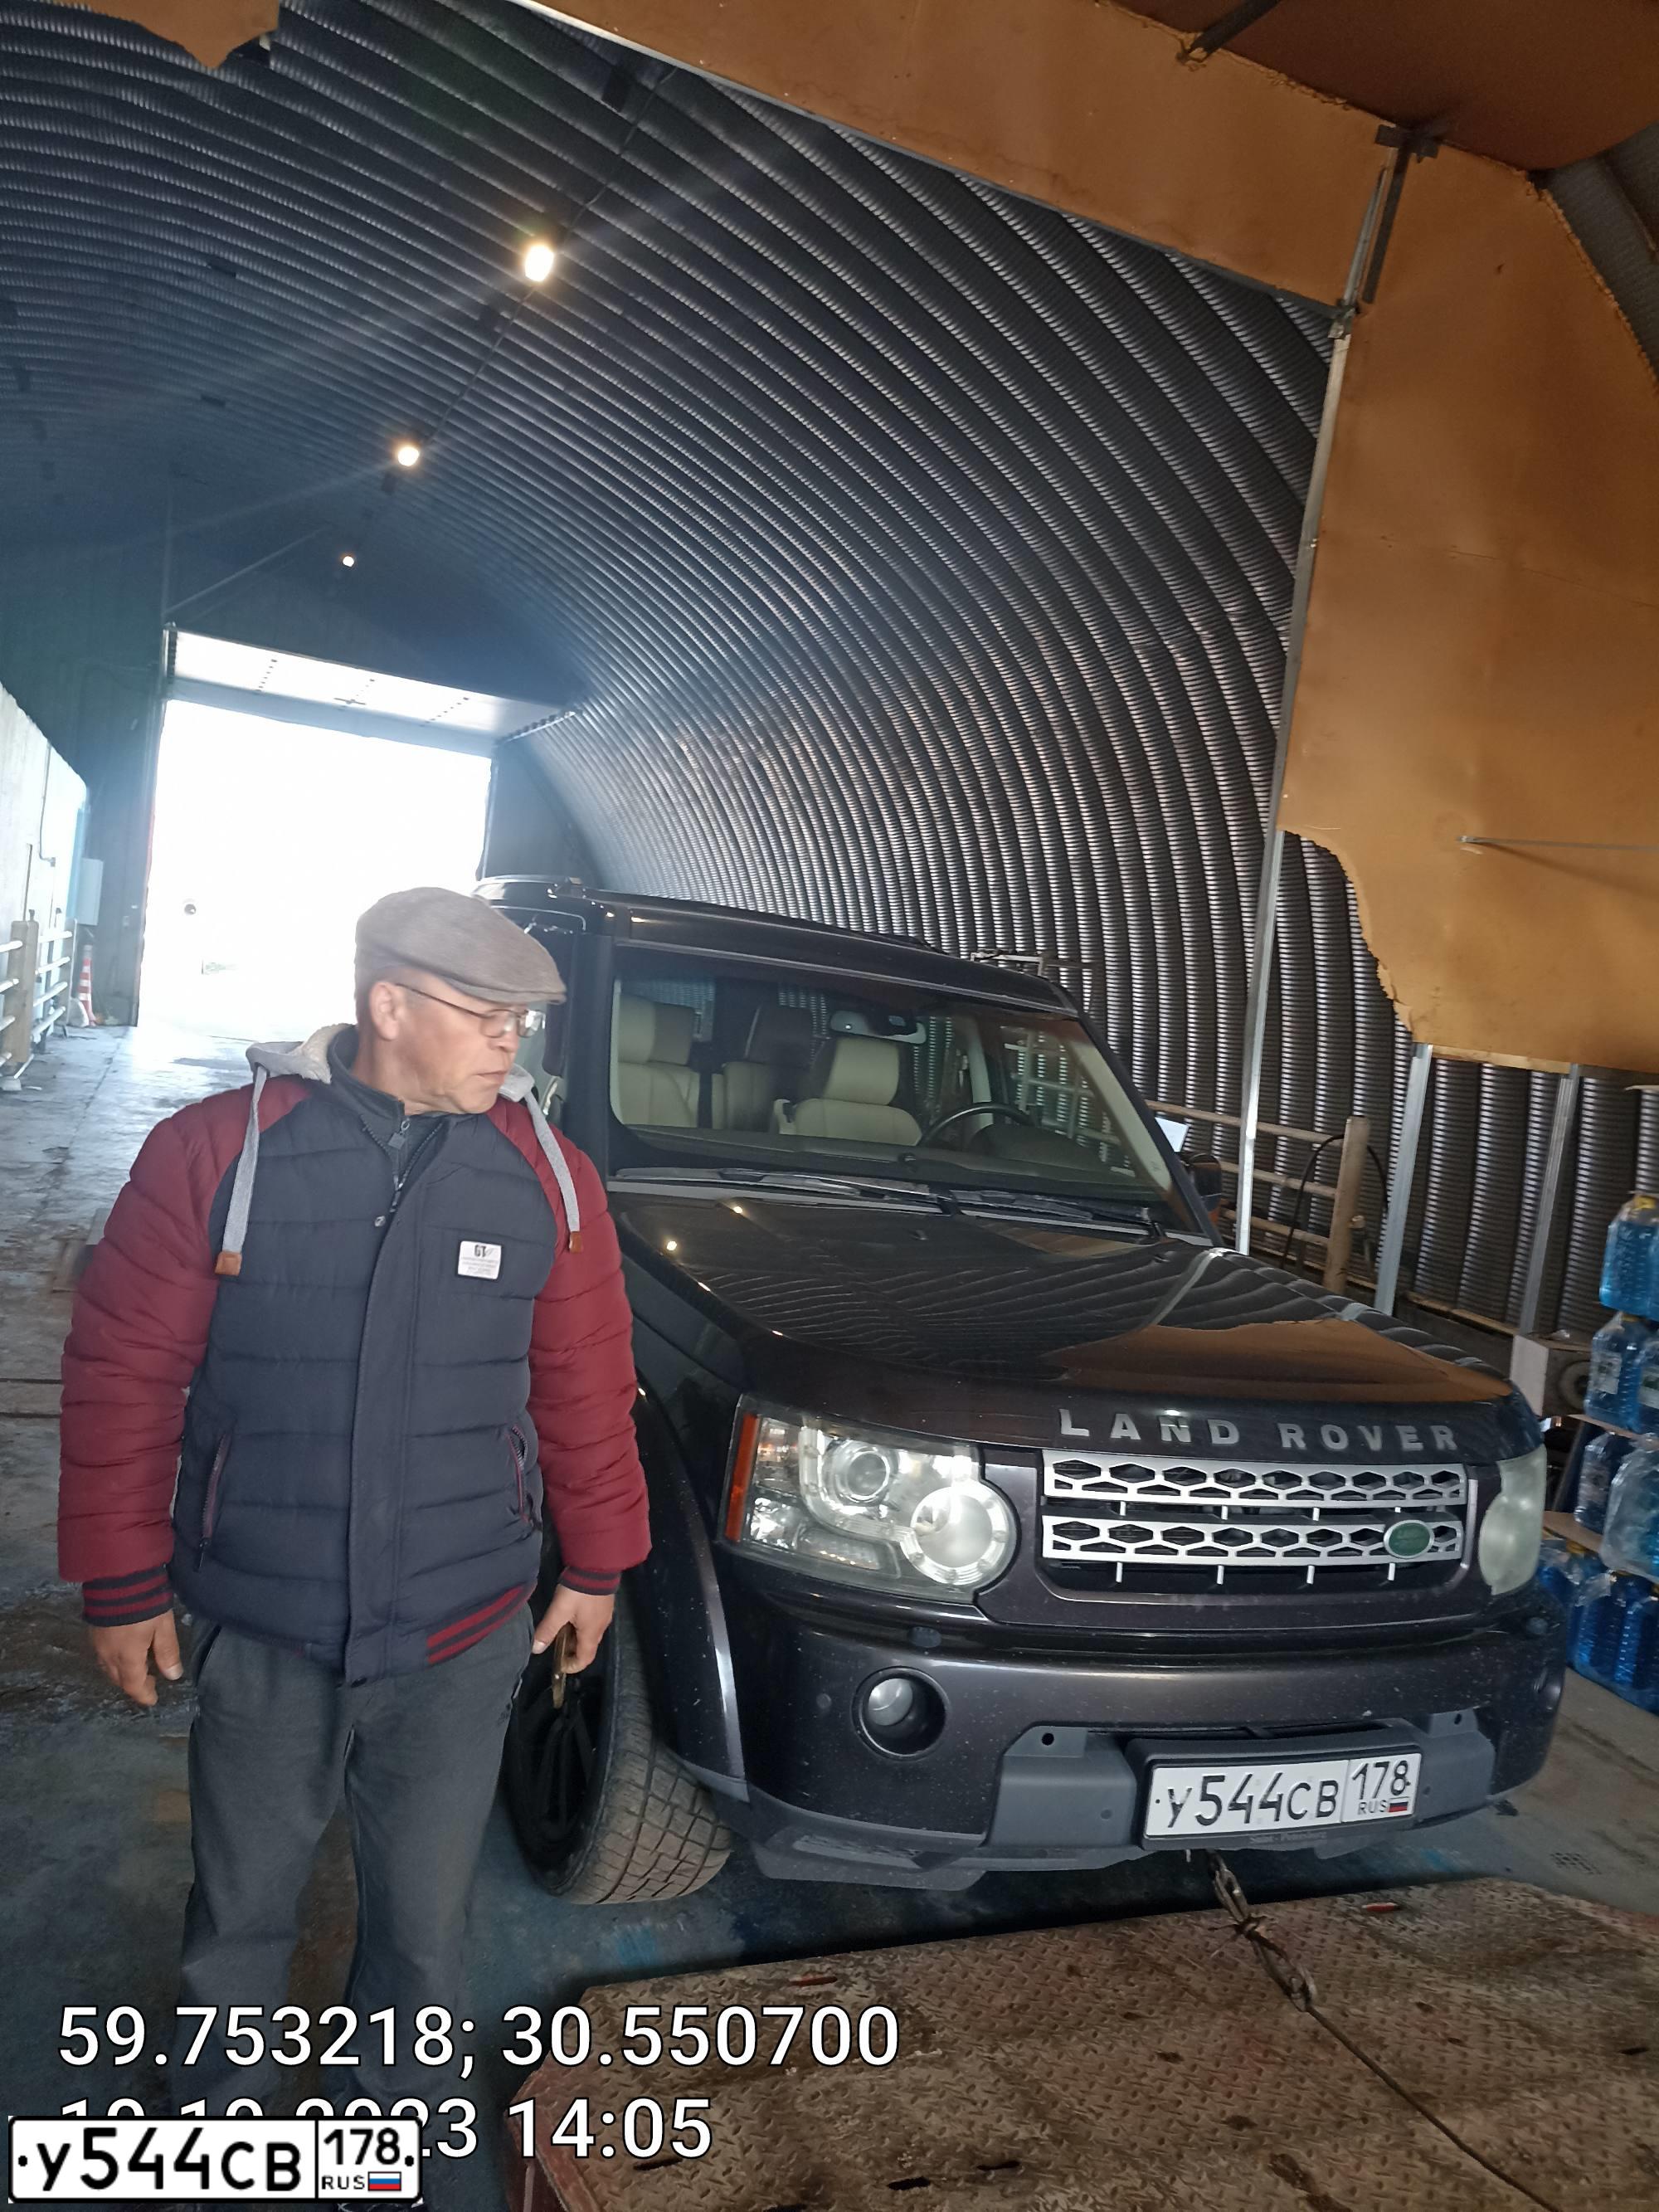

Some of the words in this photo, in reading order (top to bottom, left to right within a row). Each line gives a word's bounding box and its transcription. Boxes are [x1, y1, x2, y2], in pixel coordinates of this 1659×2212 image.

[1059, 1409, 1240, 1445] LAND
[1277, 1422, 1458, 1451] ROVER
[1167, 1771, 1339, 1828] У544СВ
[1352, 1760, 1408, 1800] 178
[1358, 1800, 1389, 1815] RUS
